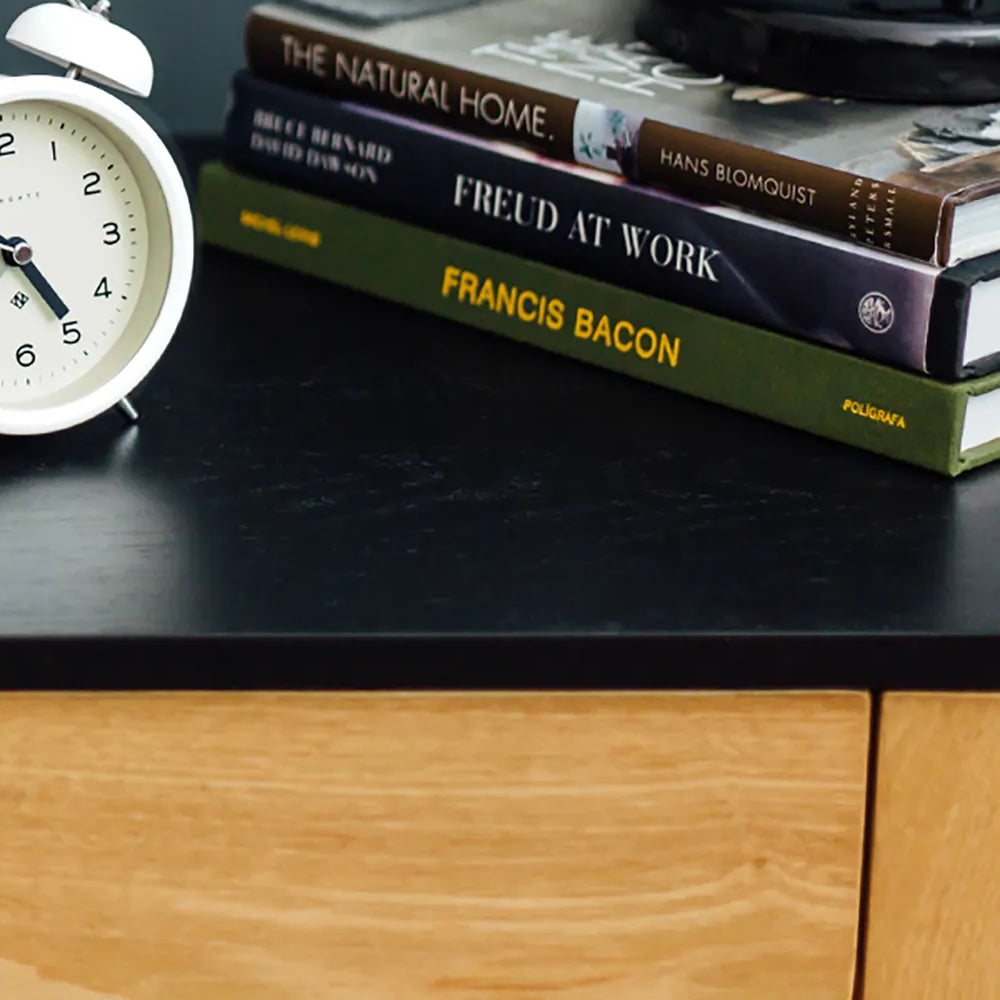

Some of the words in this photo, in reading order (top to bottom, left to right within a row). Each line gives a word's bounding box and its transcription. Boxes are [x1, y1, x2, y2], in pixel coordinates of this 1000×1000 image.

[281, 33, 327, 77] THE
[335, 52, 450, 112] NATURAL
[50, 140, 57, 161] 1
[82, 171, 101, 196] 2
[660, 147, 710, 178] HANS
[715, 161, 818, 207] BLOMQUIST
[102, 222, 121, 245] 3
[453, 173, 560, 234] FREUD
[567, 208, 612, 249] AT
[621, 221, 722, 284] WORK
[93, 276, 113, 299] 4
[441, 264, 565, 332] FRANCIS
[574, 305, 682, 368] BACON
[61, 320, 82, 345] 5
[15, 343, 36, 368] 6
